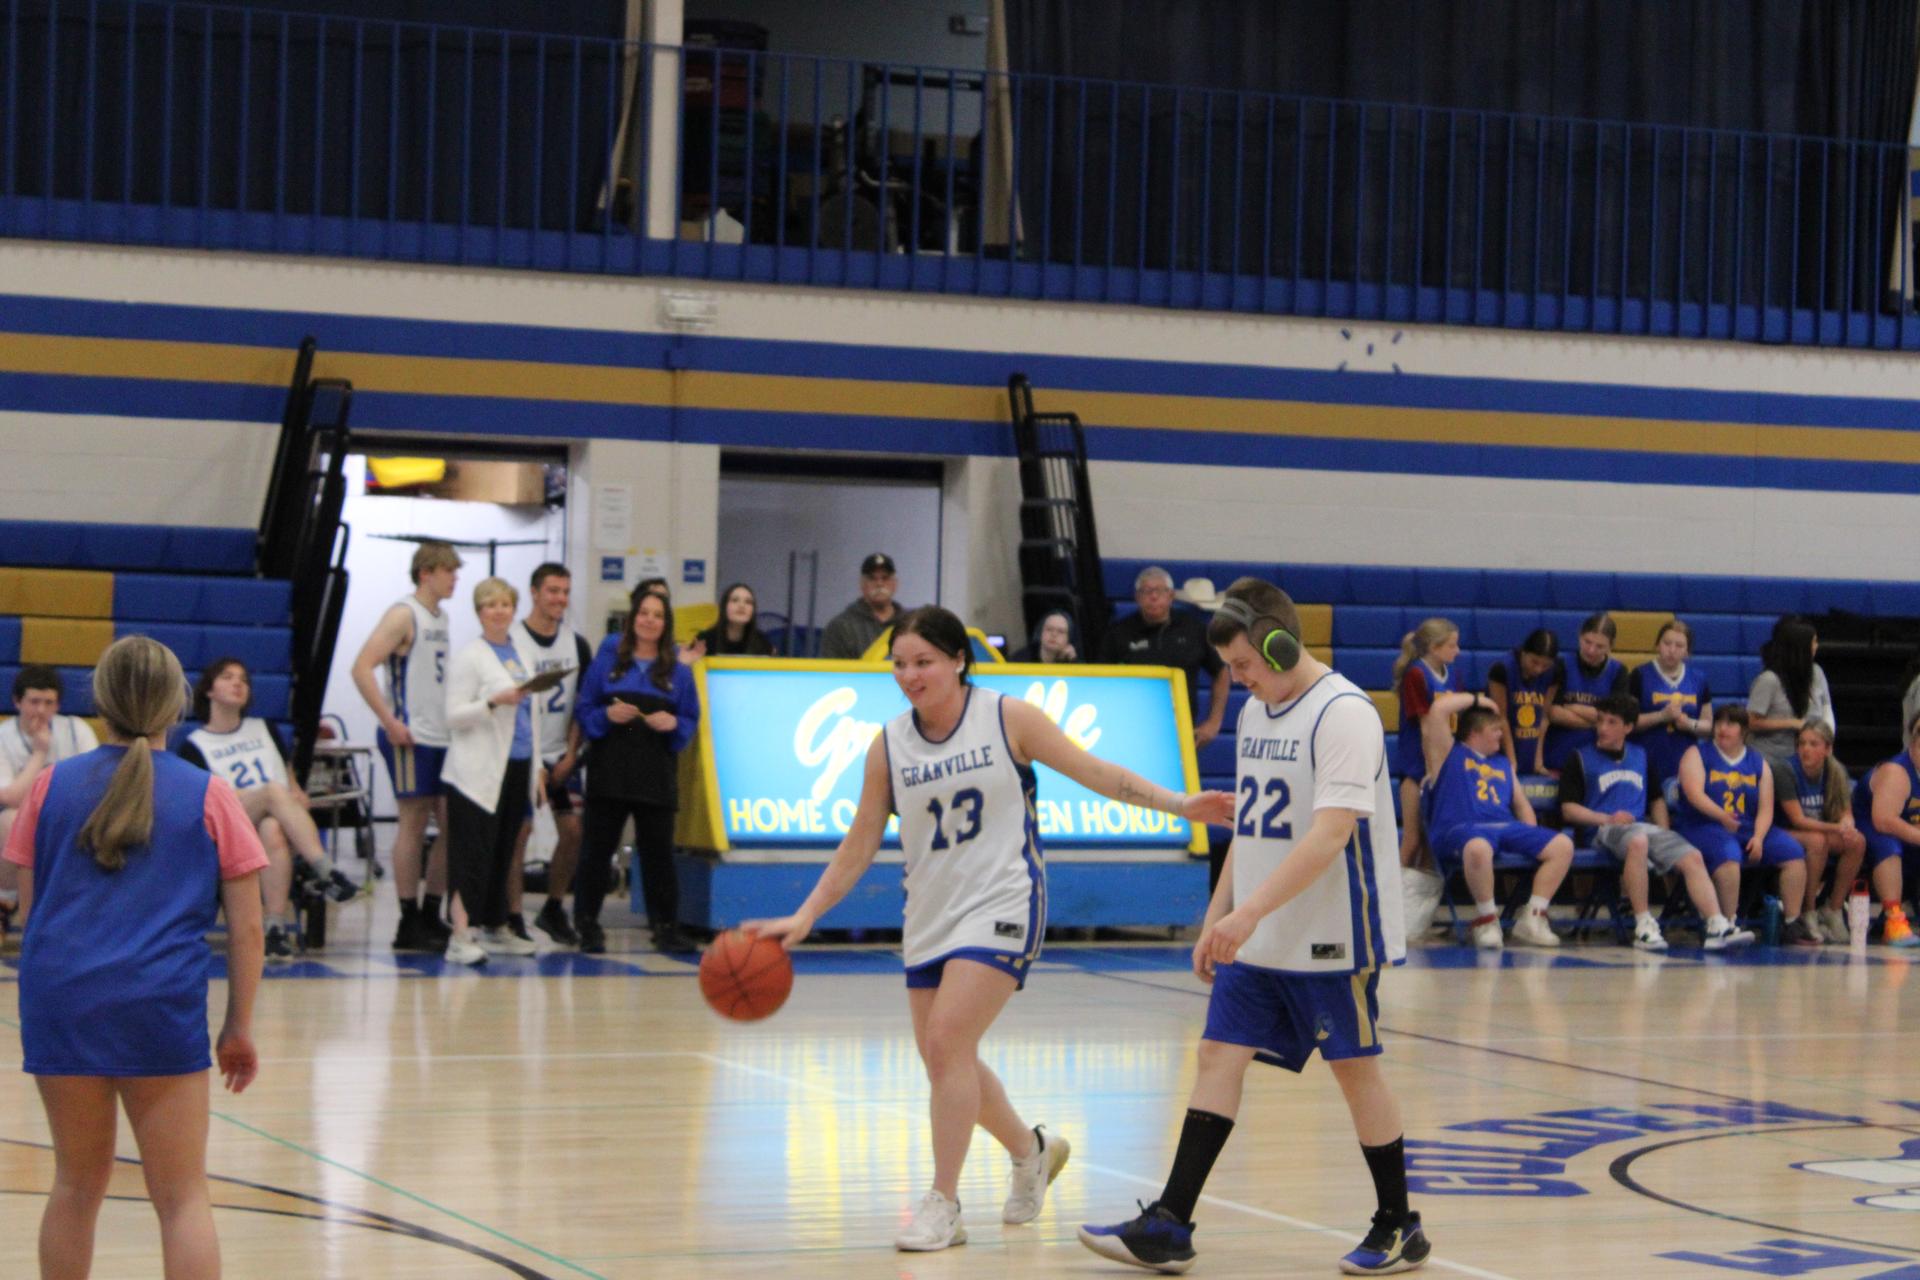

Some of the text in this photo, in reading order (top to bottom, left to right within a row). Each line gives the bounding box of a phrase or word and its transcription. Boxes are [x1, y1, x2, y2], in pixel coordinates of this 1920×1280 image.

[229, 757, 270, 789] 21
[901, 745, 993, 787] GRANVILLE
[729, 797, 826, 833] HOME
[831, 798, 858, 833] O
[1080, 799, 1183, 834] HORDE
[926, 787, 984, 851] 13
[1237, 775, 1292, 839] 22
